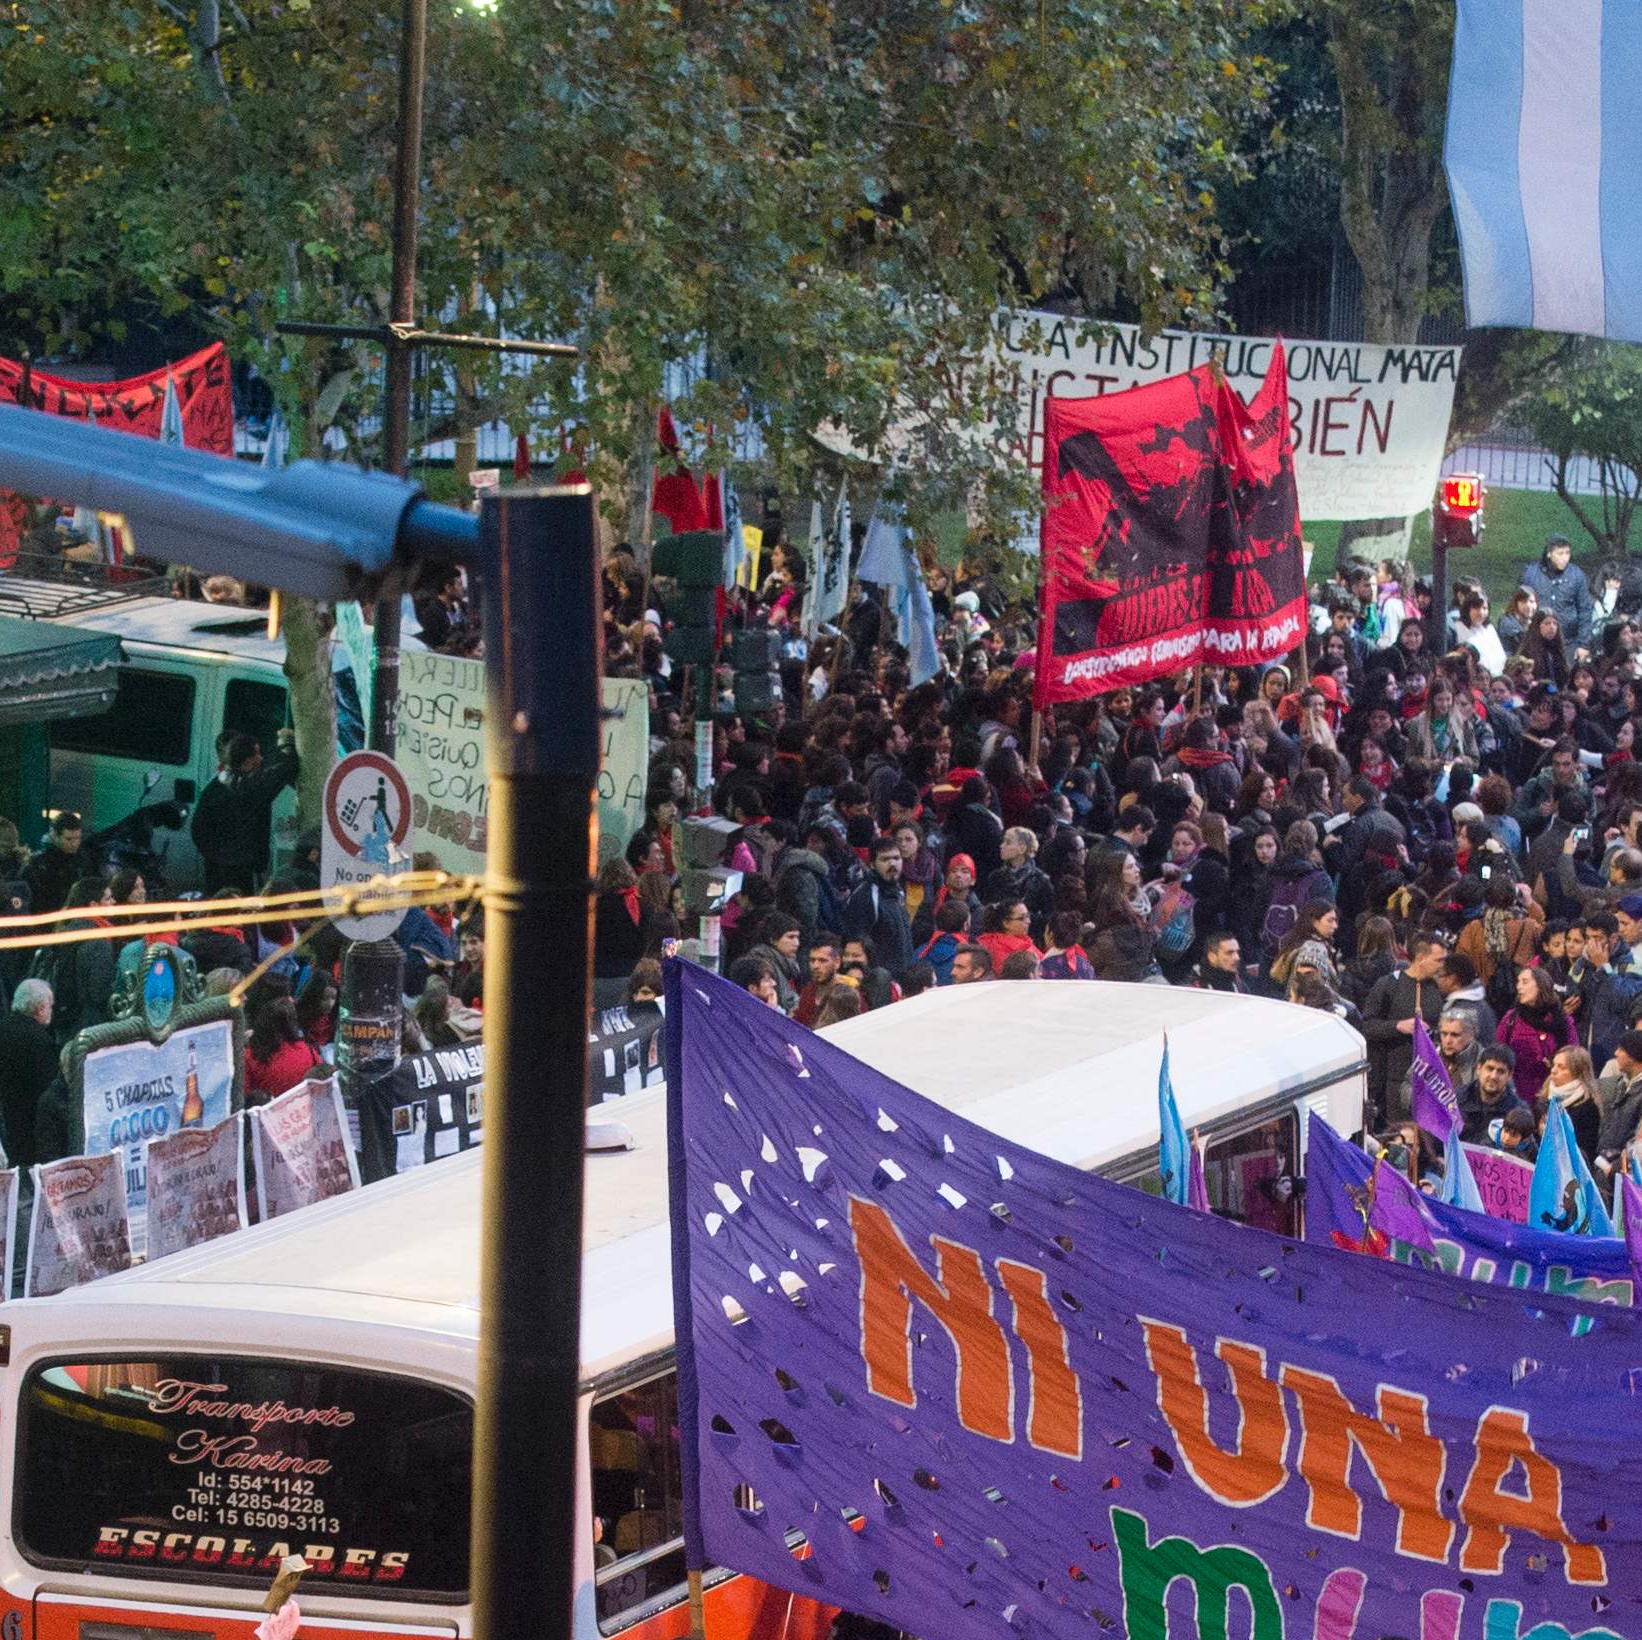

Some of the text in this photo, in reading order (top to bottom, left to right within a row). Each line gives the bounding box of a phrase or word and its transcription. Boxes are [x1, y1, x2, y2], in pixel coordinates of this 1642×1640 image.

[1095, 332, 1372, 384] INSTITUCONAL
[1378, 347, 1457, 384] MATA
[413, 1057, 436, 1089] LA
[104, 1089, 115, 1113] 5
[147, 1378, 356, 1433] Transporte
[847, 1192, 1084, 1462] NI
[1137, 1313, 1609, 1588] UNA
[168, 1429, 334, 1476] Karina
[198, 1471, 223, 1489] Id:
[171, 1505, 341, 1535] Cel: 15 6509-3113
[187, 1488, 325, 1515] Tel: 4285-4228
[93, 1526, 411, 1583] ESCOLARES
